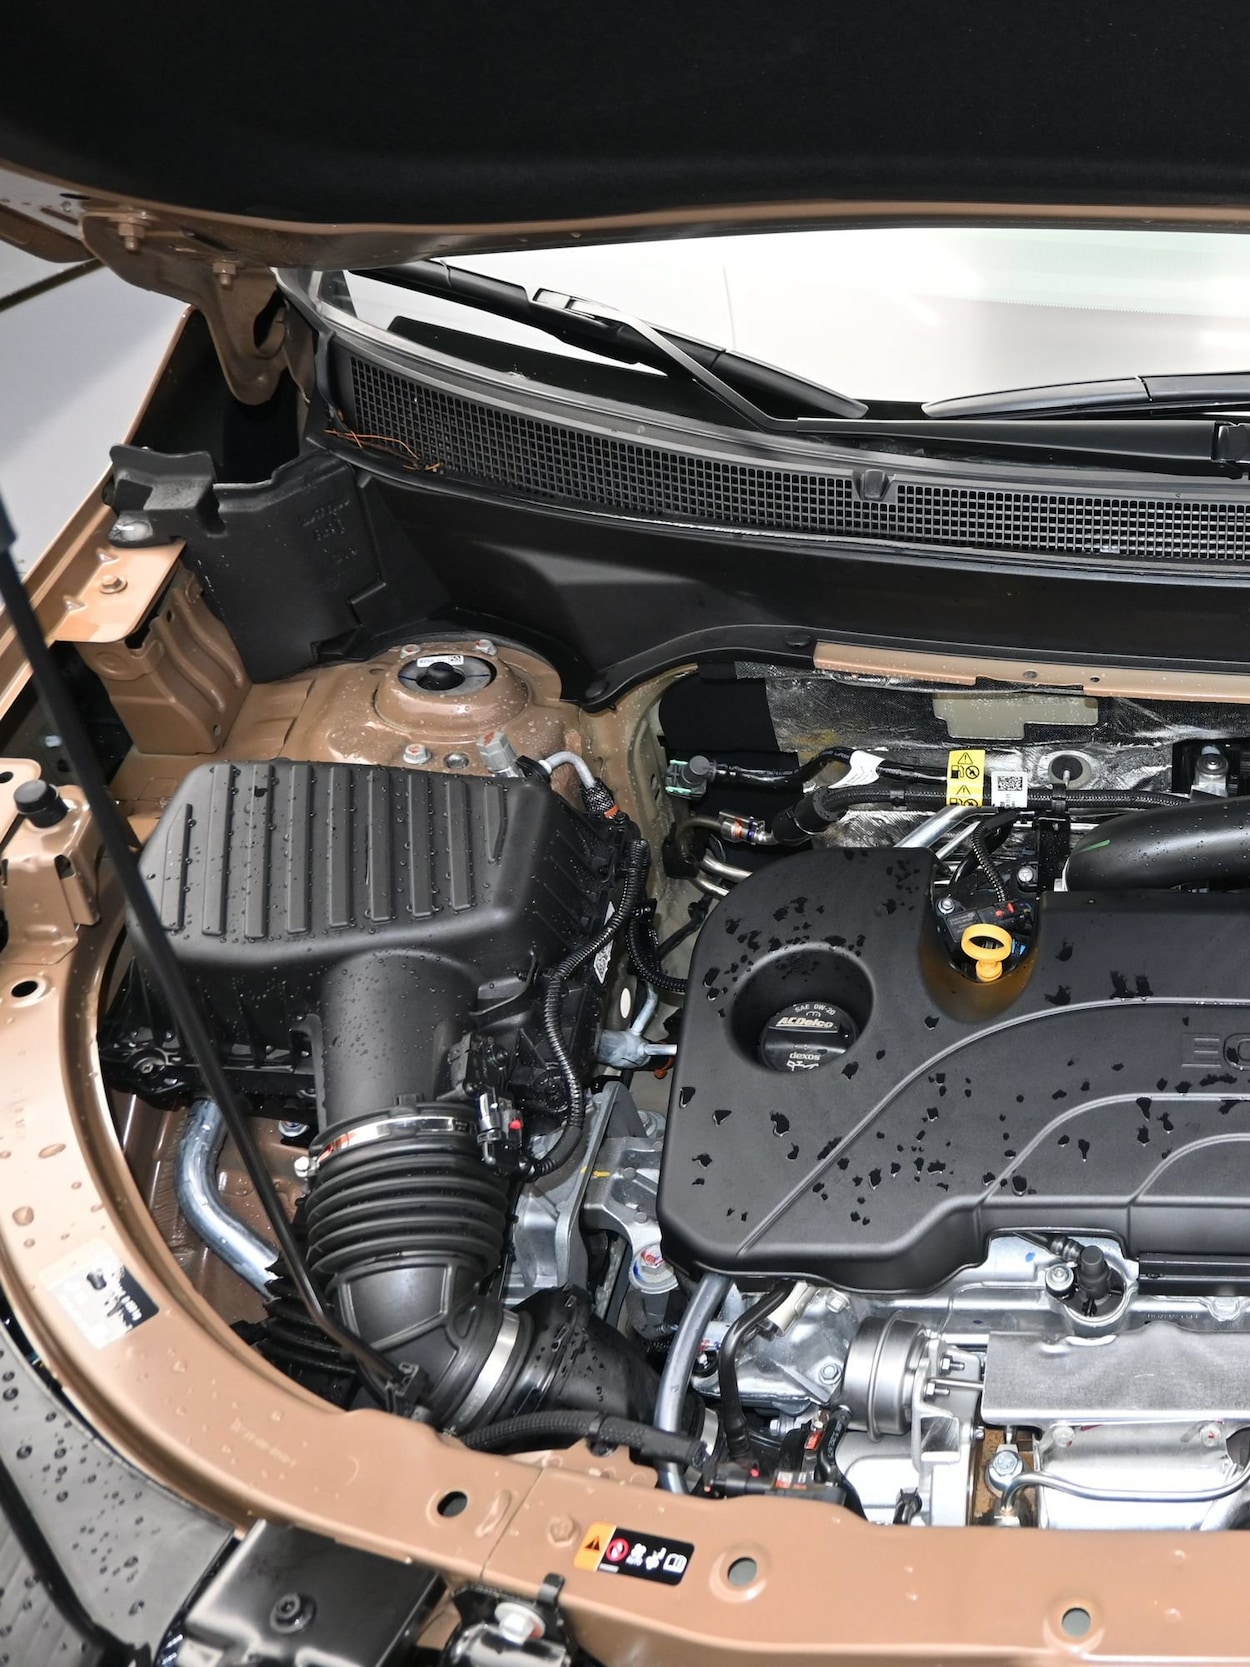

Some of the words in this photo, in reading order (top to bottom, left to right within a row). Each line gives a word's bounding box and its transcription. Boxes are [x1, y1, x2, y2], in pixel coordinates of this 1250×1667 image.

[794, 1003, 810, 1013] SAE
[775, 1016, 834, 1028] ACDelco
[789, 1051, 821, 1061] dexos
